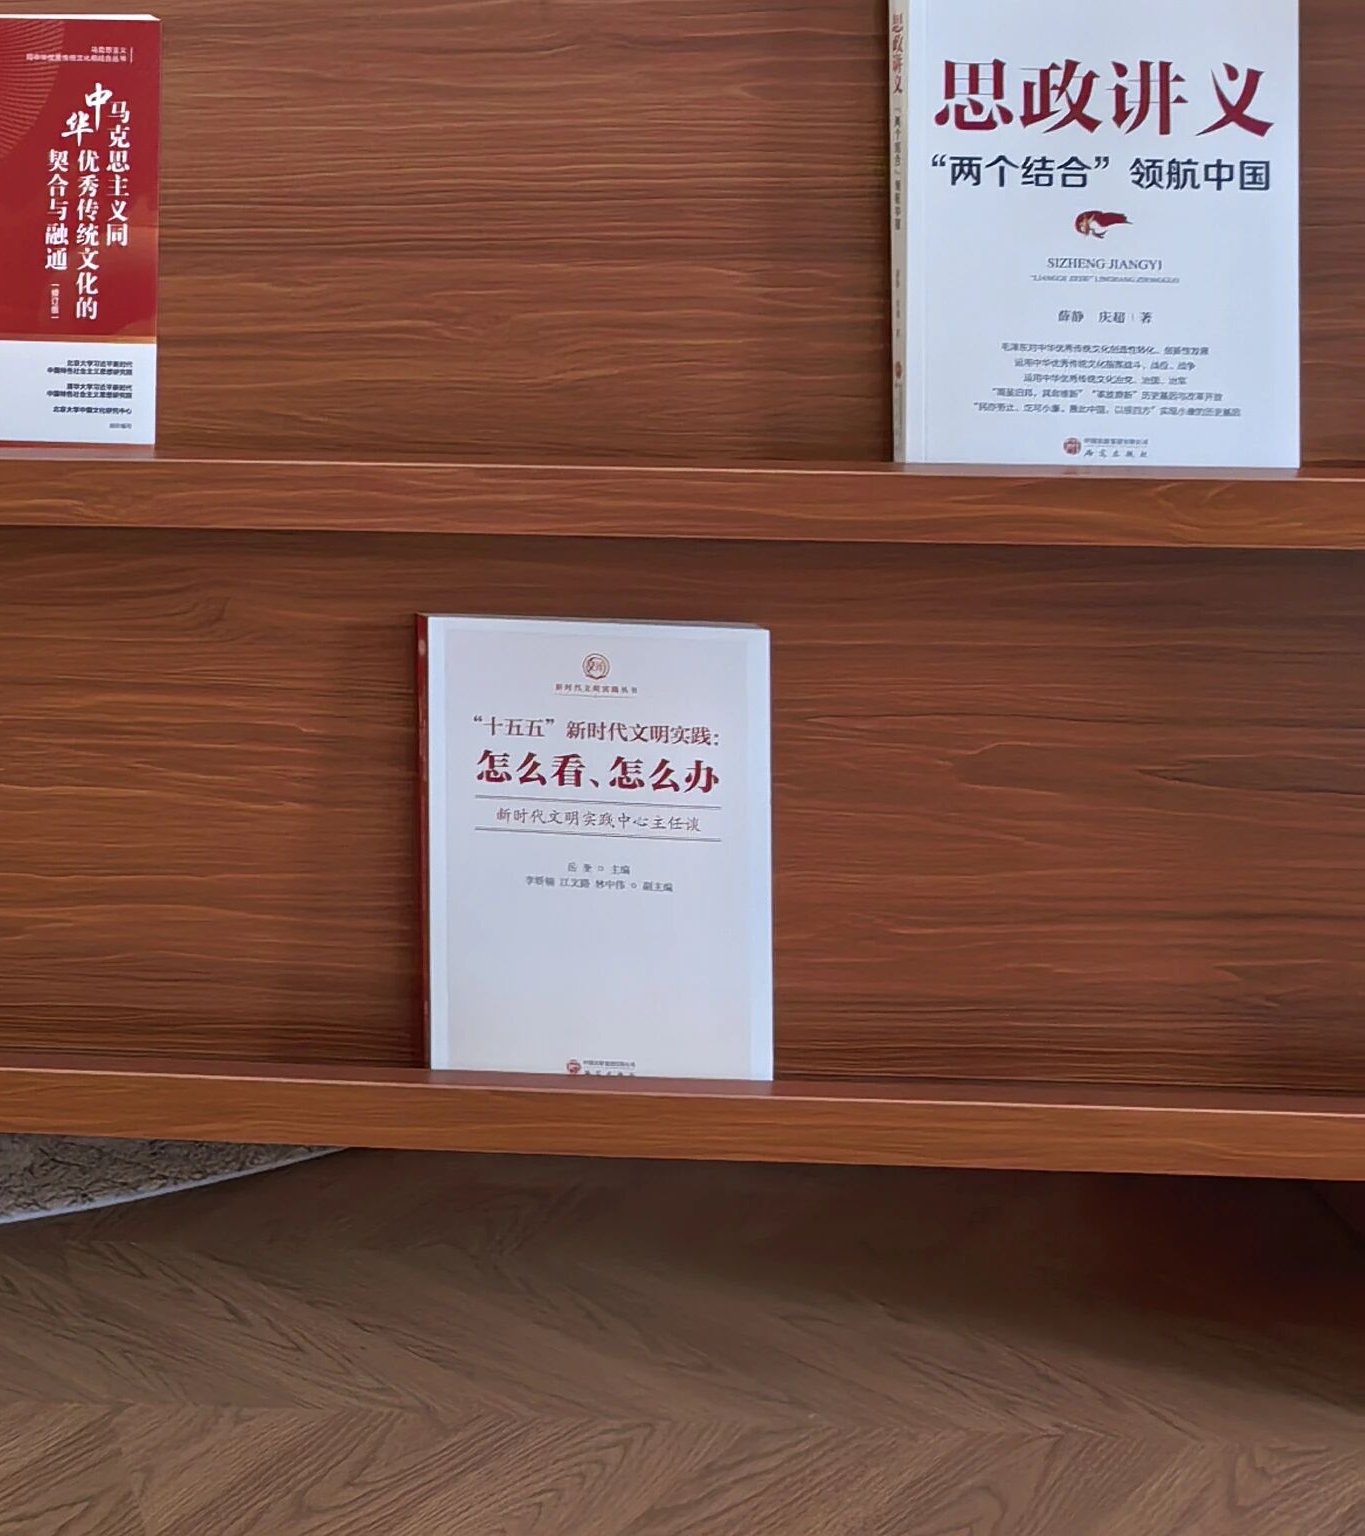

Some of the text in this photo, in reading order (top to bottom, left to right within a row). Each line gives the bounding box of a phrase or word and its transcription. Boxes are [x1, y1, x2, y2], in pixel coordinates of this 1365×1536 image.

[933, 57, 1275, 139] 思政讲义
[106, 101, 131, 247] 马克思主义同
[44, 148, 69, 271] 契合与融通
[1047, 258, 1105, 269] SIZHENG
[1140, 311, 1152, 324] 著
[476, 749, 720, 794] 怎么看、怎么办
[496, 807, 701, 832] 新时代文明实践中心主任谈
